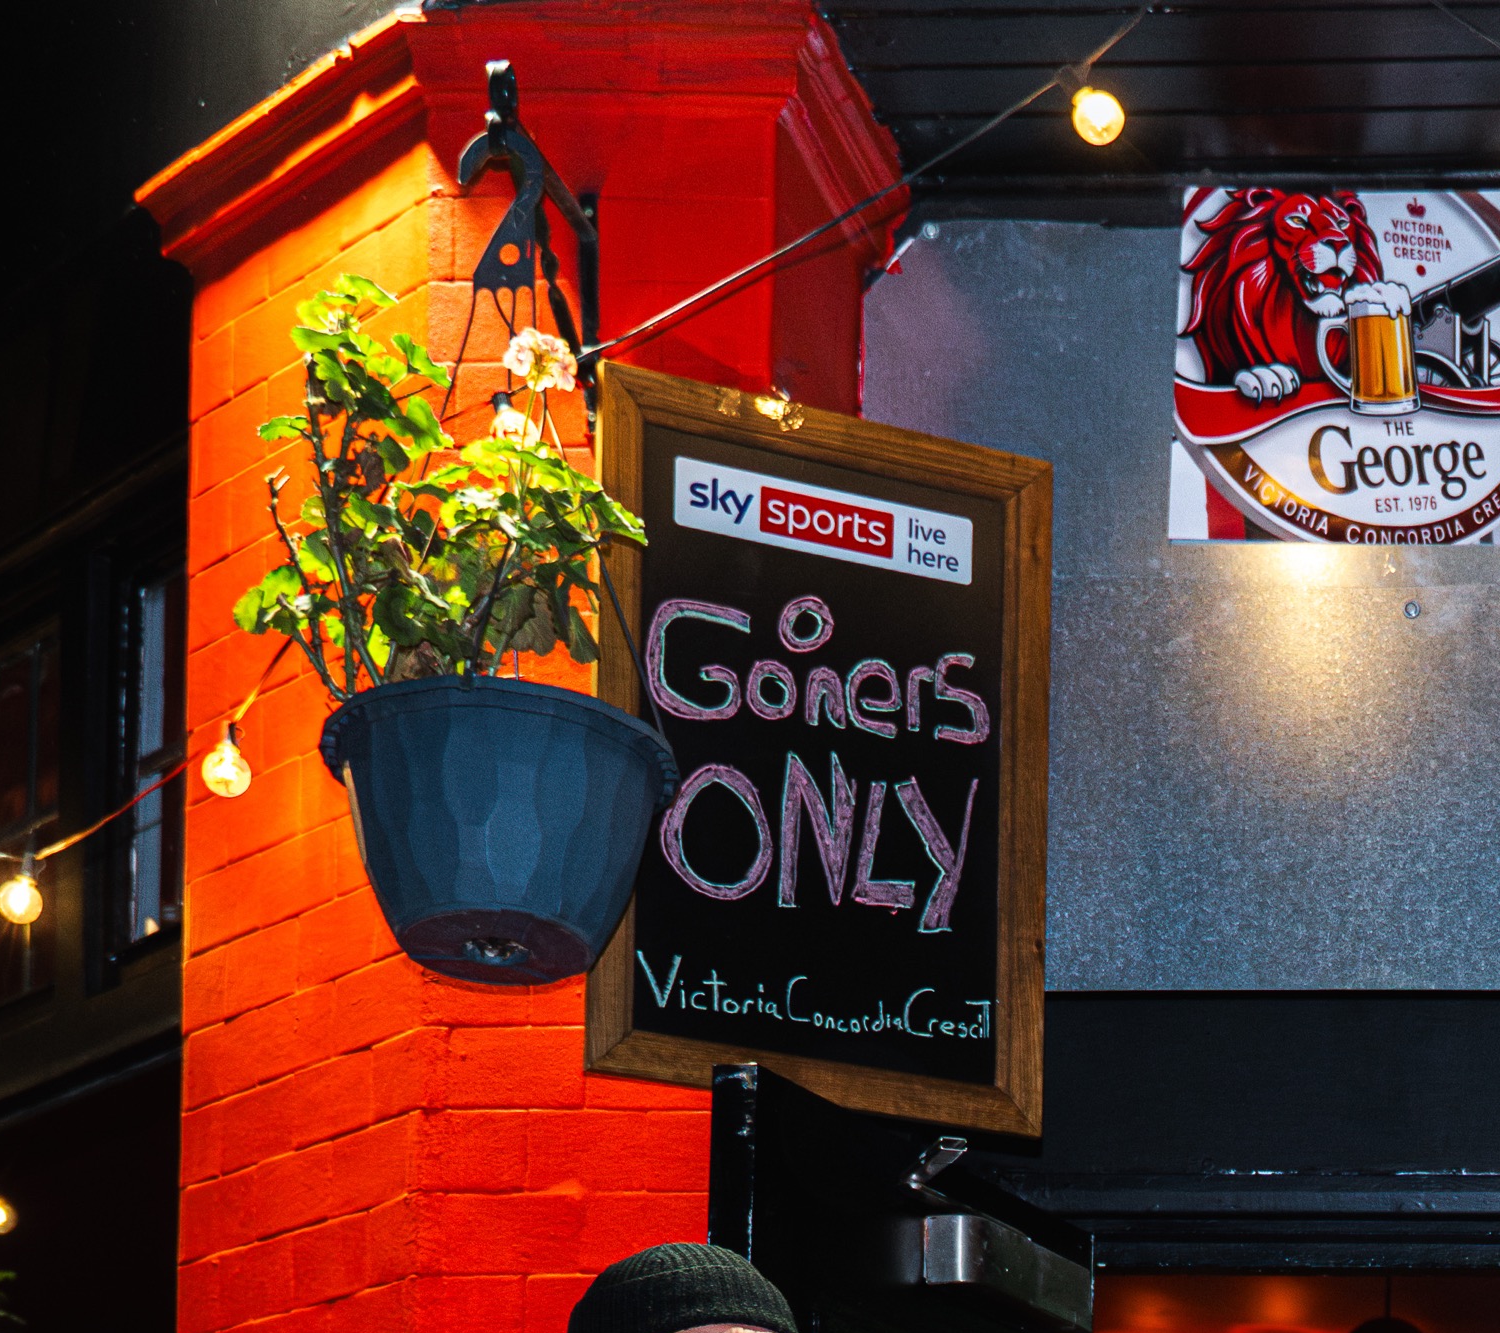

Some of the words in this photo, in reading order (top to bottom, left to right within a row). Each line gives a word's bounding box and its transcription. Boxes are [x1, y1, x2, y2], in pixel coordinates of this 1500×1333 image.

[1391, 219, 1444, 236] VICTORIA
[1384, 231, 1452, 252] CONCORDIA
[1393, 246, 1442, 263] CRESCIT
[1383, 420, 1415, 437] THE
[1308, 425, 1487, 501] George
[689, 478, 754, 524] sky
[767, 501, 886, 548] sports
[1243, 463, 1330, 536] VICTORIA
[1346, 519, 1466, 545] CONCORDIA
[1375, 498, 1404, 513] EST.
[1408, 496, 1438, 511] 1976
[907, 517, 947, 545] live
[907, 546, 960, 573] here
[661, 752, 980, 934] ONLY
[636, 950, 783, 1020] Victoria
[786, 975, 904, 1033] Concordia
